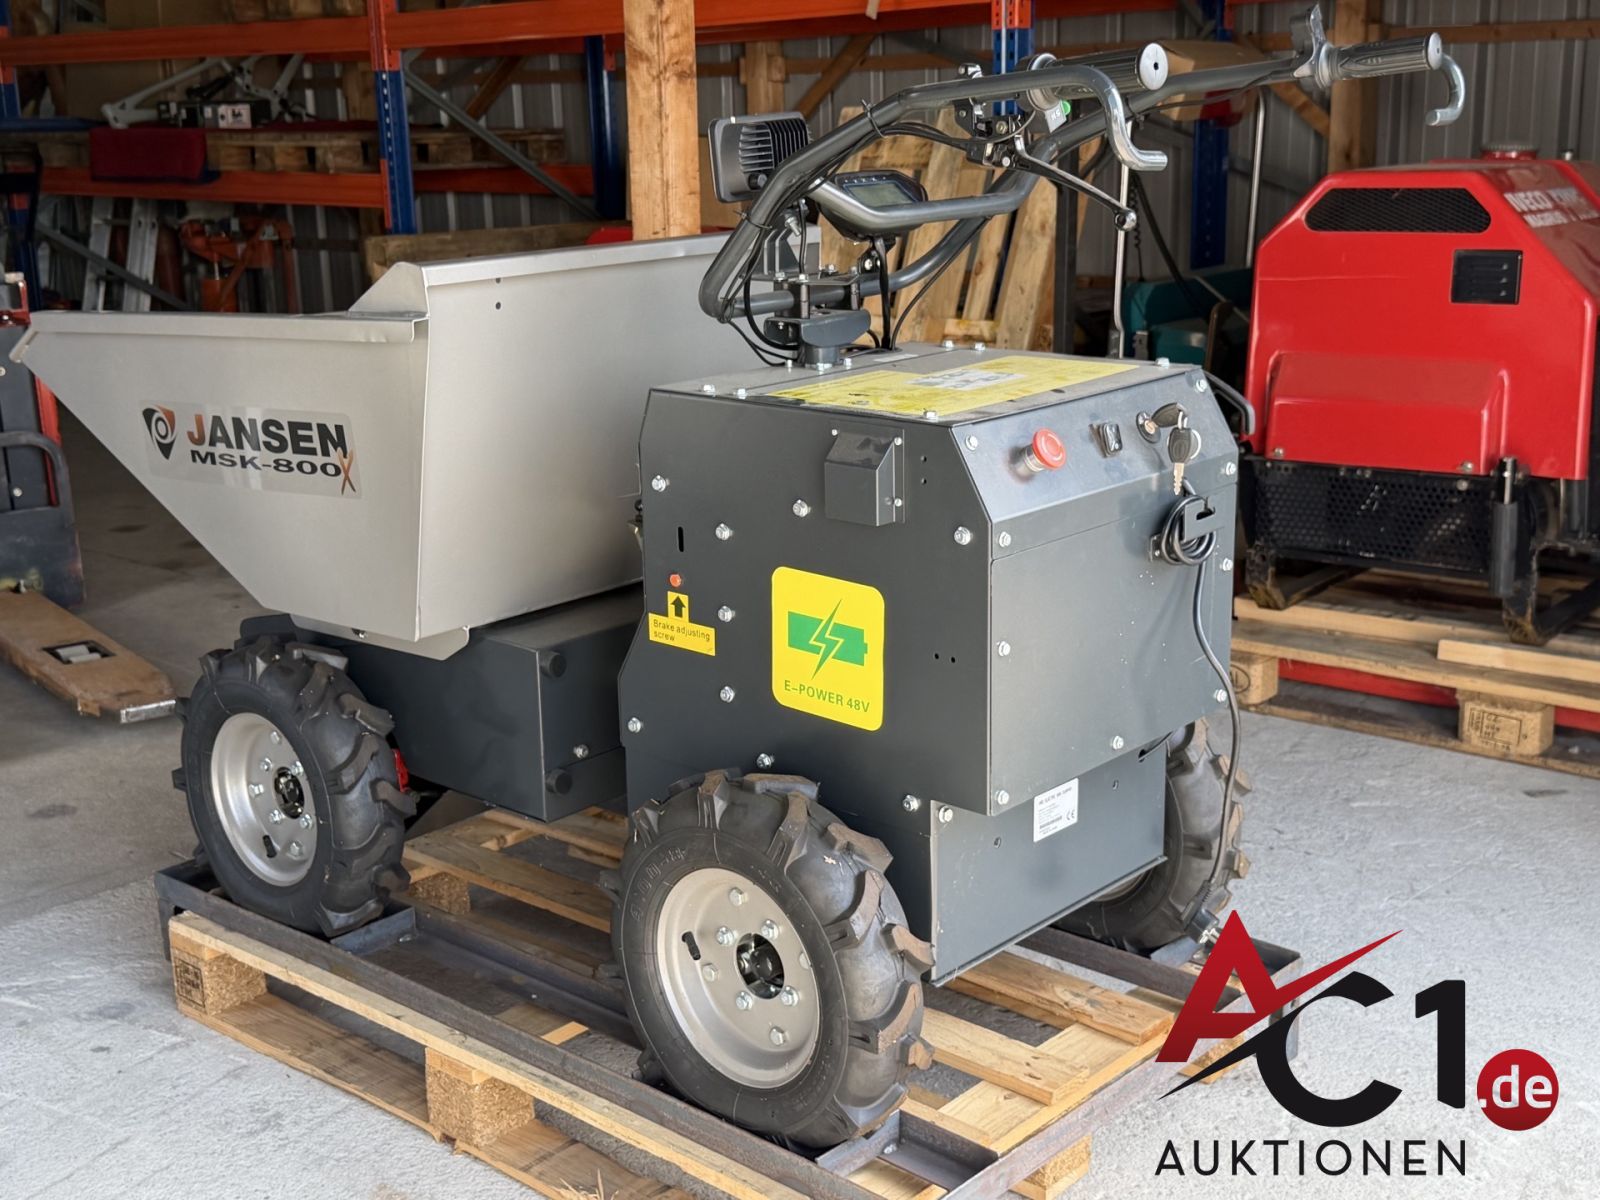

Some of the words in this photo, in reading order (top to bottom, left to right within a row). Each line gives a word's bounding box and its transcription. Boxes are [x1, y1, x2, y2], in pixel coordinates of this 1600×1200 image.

[186, 413, 349, 459] JANSEN
[653, 618, 675, 632] Brake
[676, 625, 711, 643] adjusting
[653, 630, 676, 642] screw
[784, 679, 844, 707] E-POWER
[846, 698, 870, 713] 48V
